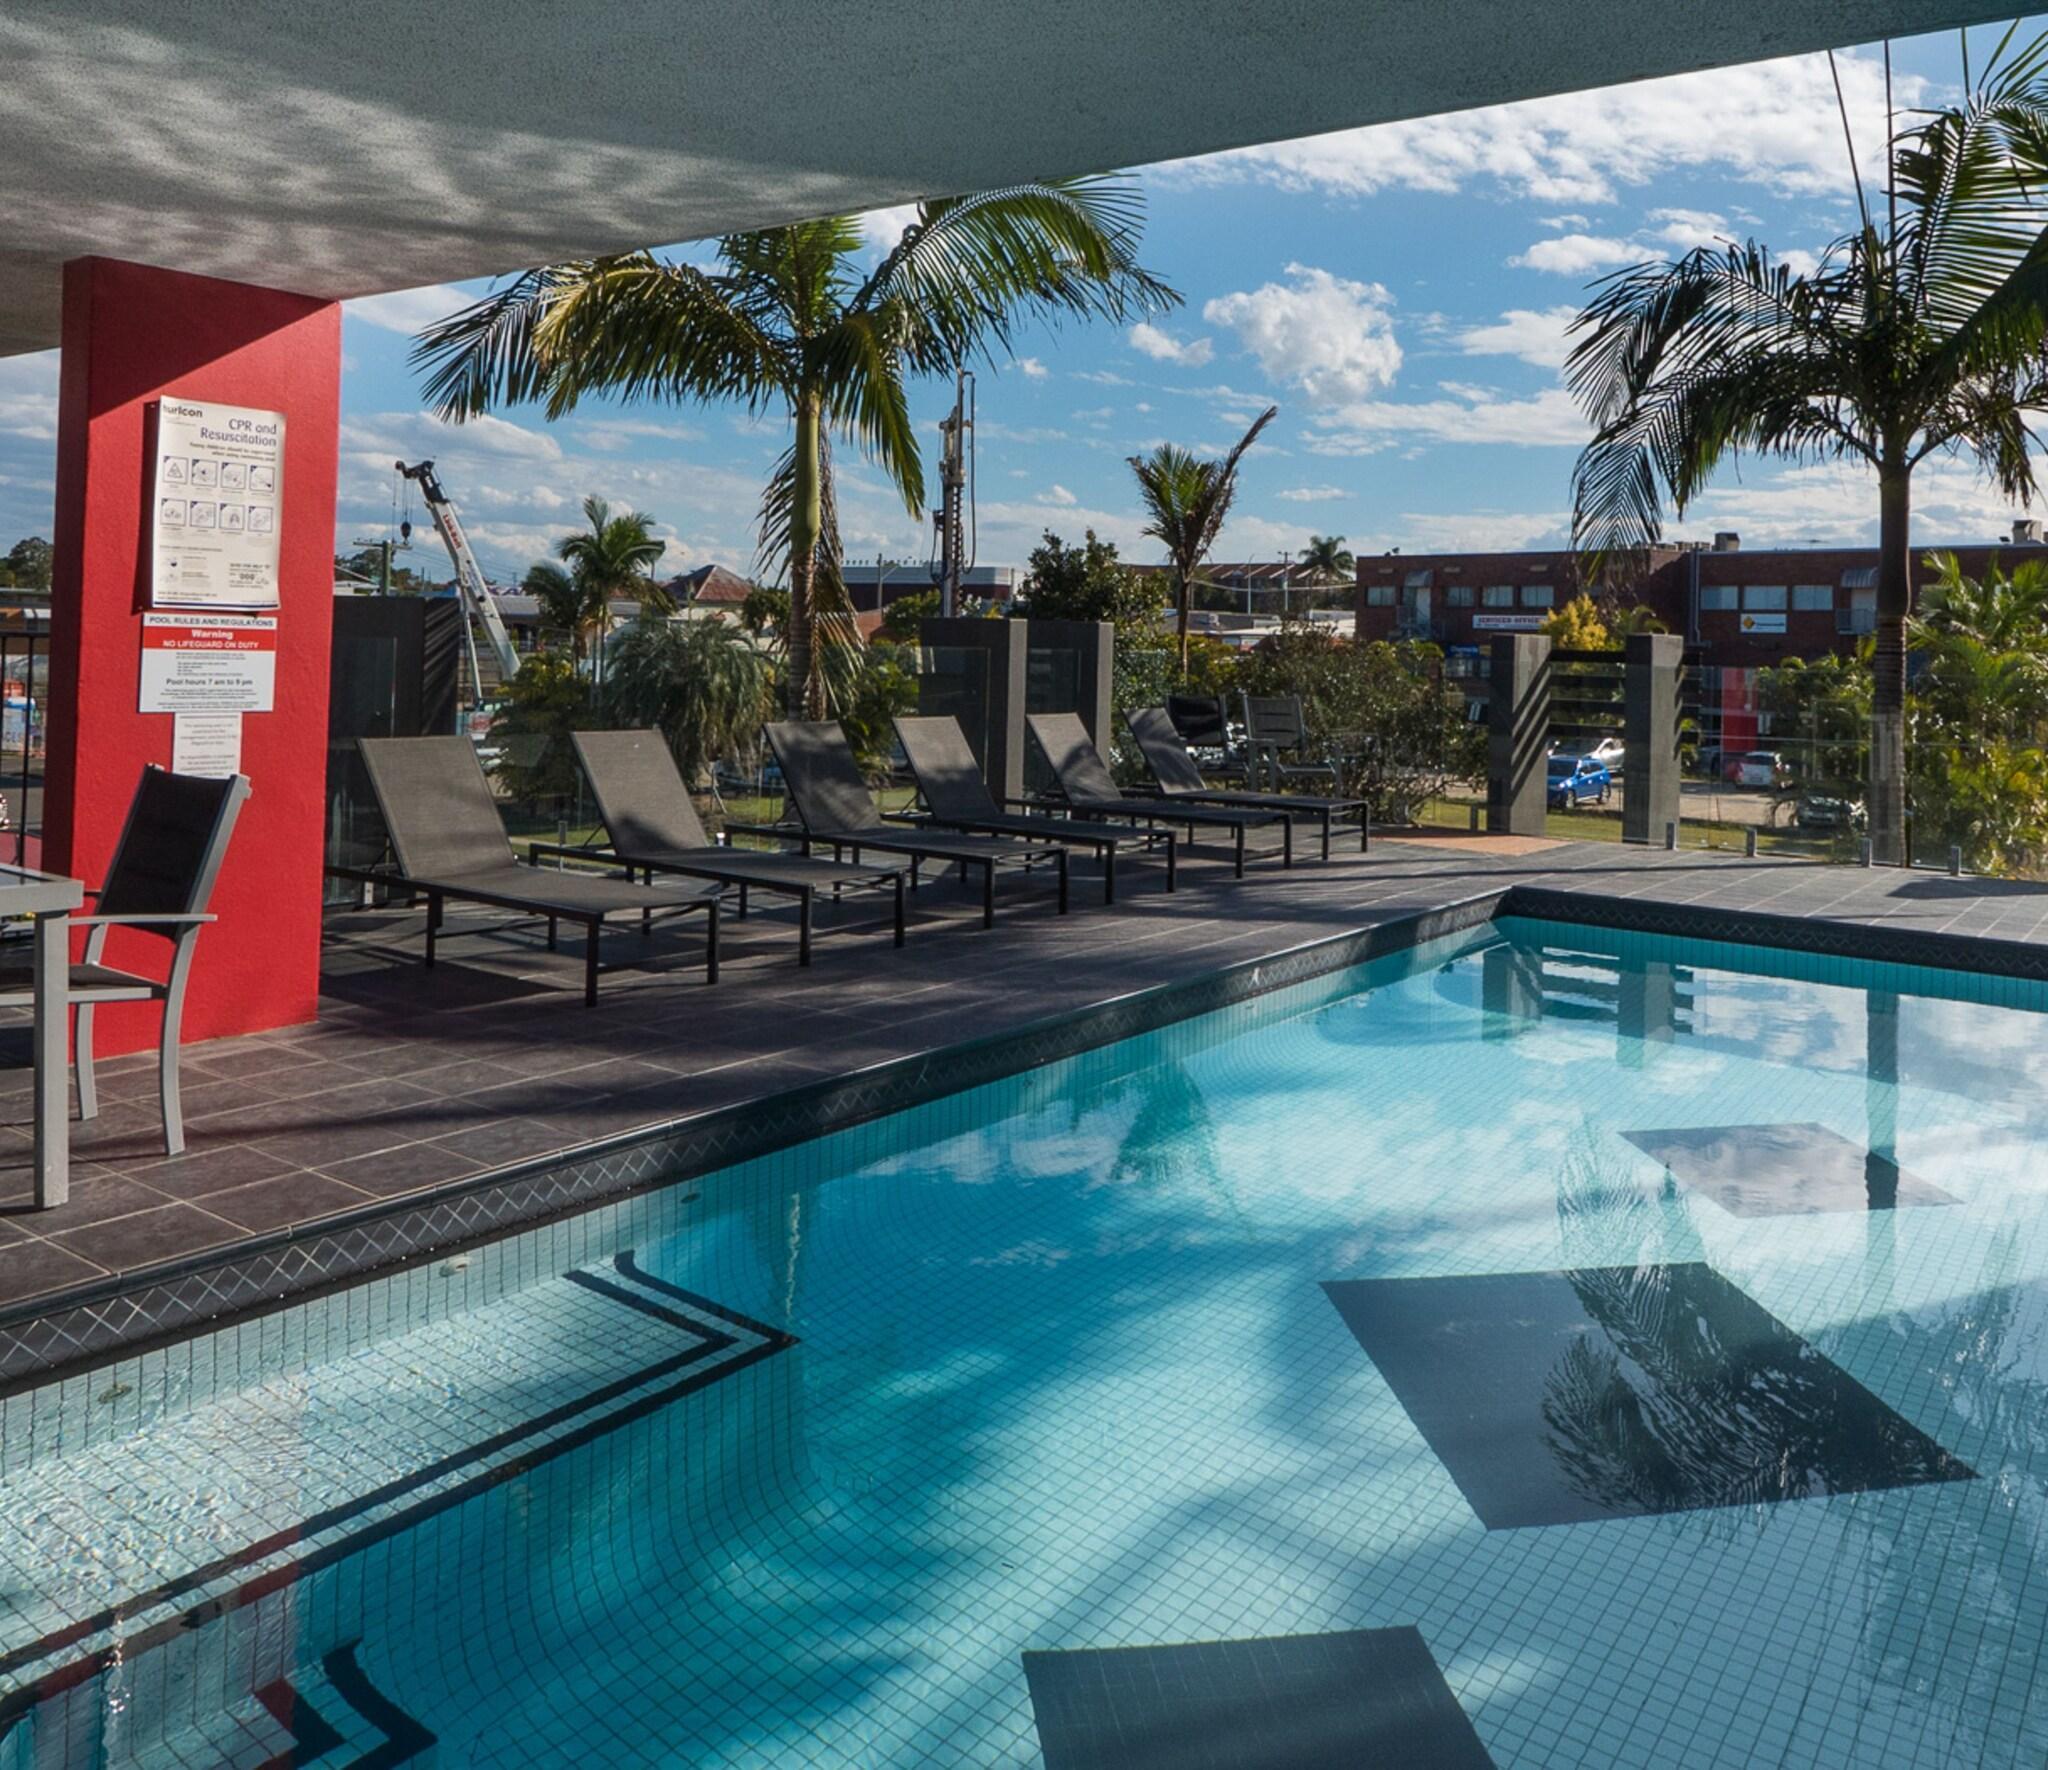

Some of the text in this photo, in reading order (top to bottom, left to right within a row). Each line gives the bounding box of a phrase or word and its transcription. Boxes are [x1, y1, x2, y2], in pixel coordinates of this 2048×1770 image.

[228, 418, 277, 434] CPR and
[200, 427, 277, 447] Resuscitation
[149, 616, 170, 624] POOL
[174, 617, 200, 625] RULES
[220, 618, 273, 627] REGULATIONS
[191, 629, 234, 640] Warning
[177, 640, 223, 648] LIFEGUARD
[237, 641, 259, 649] DUTY
